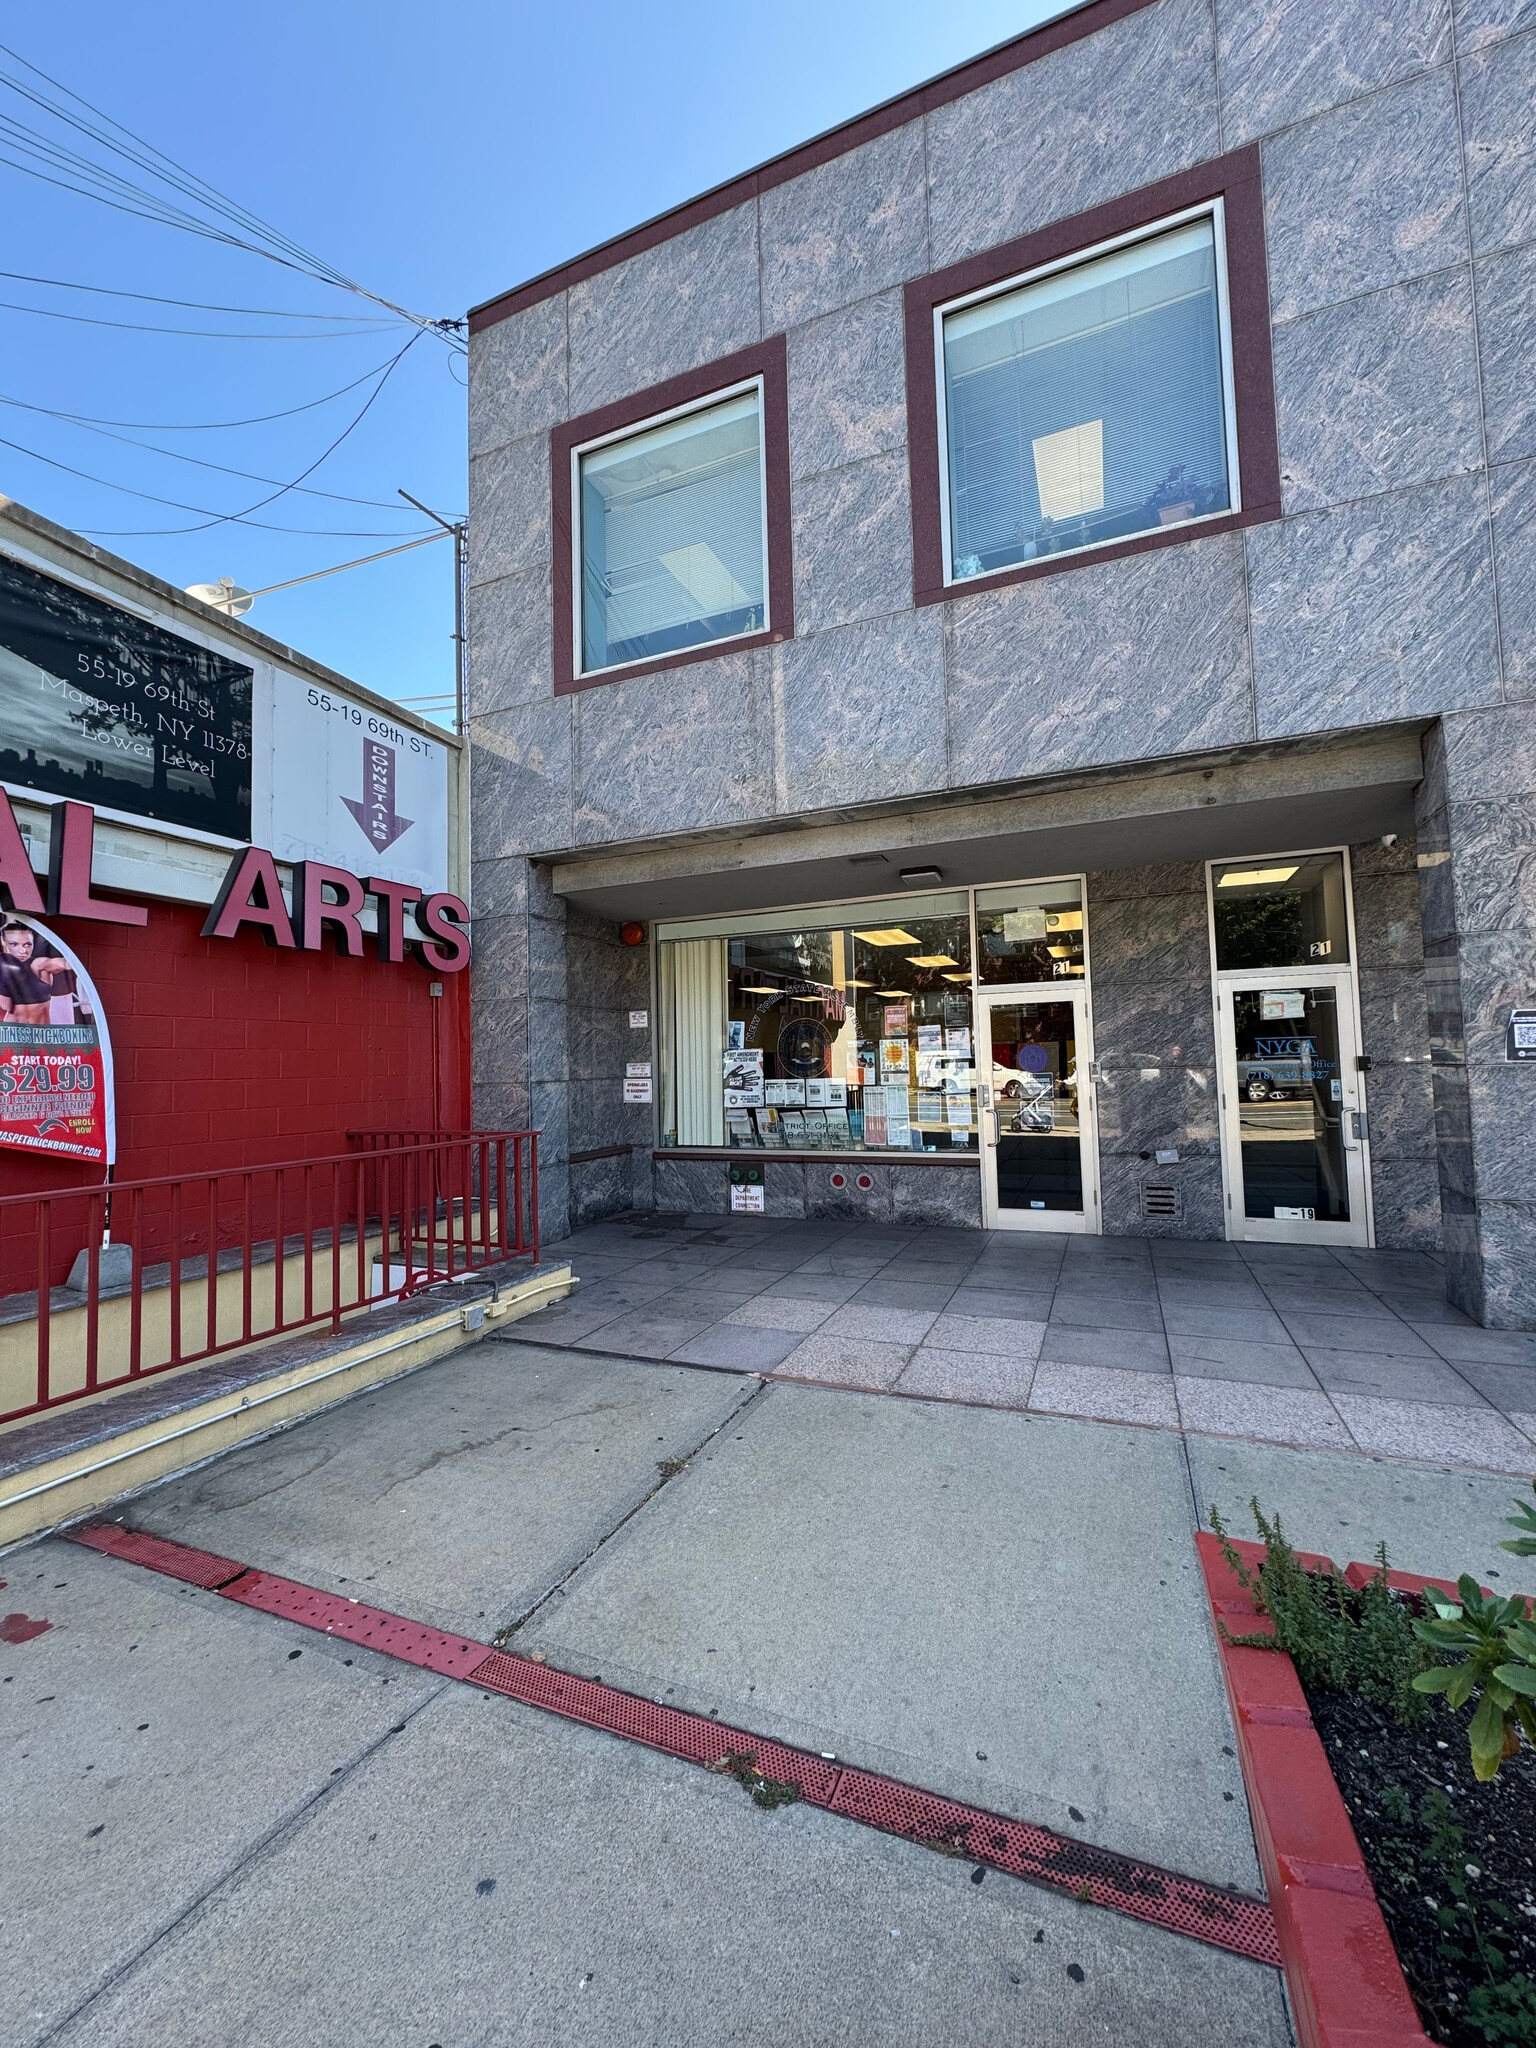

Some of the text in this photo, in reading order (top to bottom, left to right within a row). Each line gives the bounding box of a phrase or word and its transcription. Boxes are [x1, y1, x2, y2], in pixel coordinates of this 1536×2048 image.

[78, 653, 216, 721] 55-19 69th St
[39, 671, 247, 760] Maspeth, NY 11378
[307, 689, 433, 760] 55-19 69th ST.
[81, 718, 216, 778] Lower Level
[371, 744, 389, 840] DOWNSTAIRS
[201, 847, 471, 973] ARTS
[1312, 943, 1327, 955] 21
[1054, 963, 1067, 974] 21
[746, 1014, 761, 1043] NEW
[757, 991, 784, 1014] YORK
[785, 985, 822, 996] STATE
[824, 988, 866, 1039] ASSEMBLY
[0, 1026, 94, 1044] TNESS KICKBOXING
[11, 1055, 82, 1066] START TODAY!
[1309, 1060, 1337, 1068] Office
[0, 1063, 95, 1096] $29.99
[1246, 1071, 1274, 1081] (718)
[69, 1118, 96, 1127] ENROLL
[75, 1126, 92, 1136] NOW
[814, 1121, 848, 1130] OFFICE
